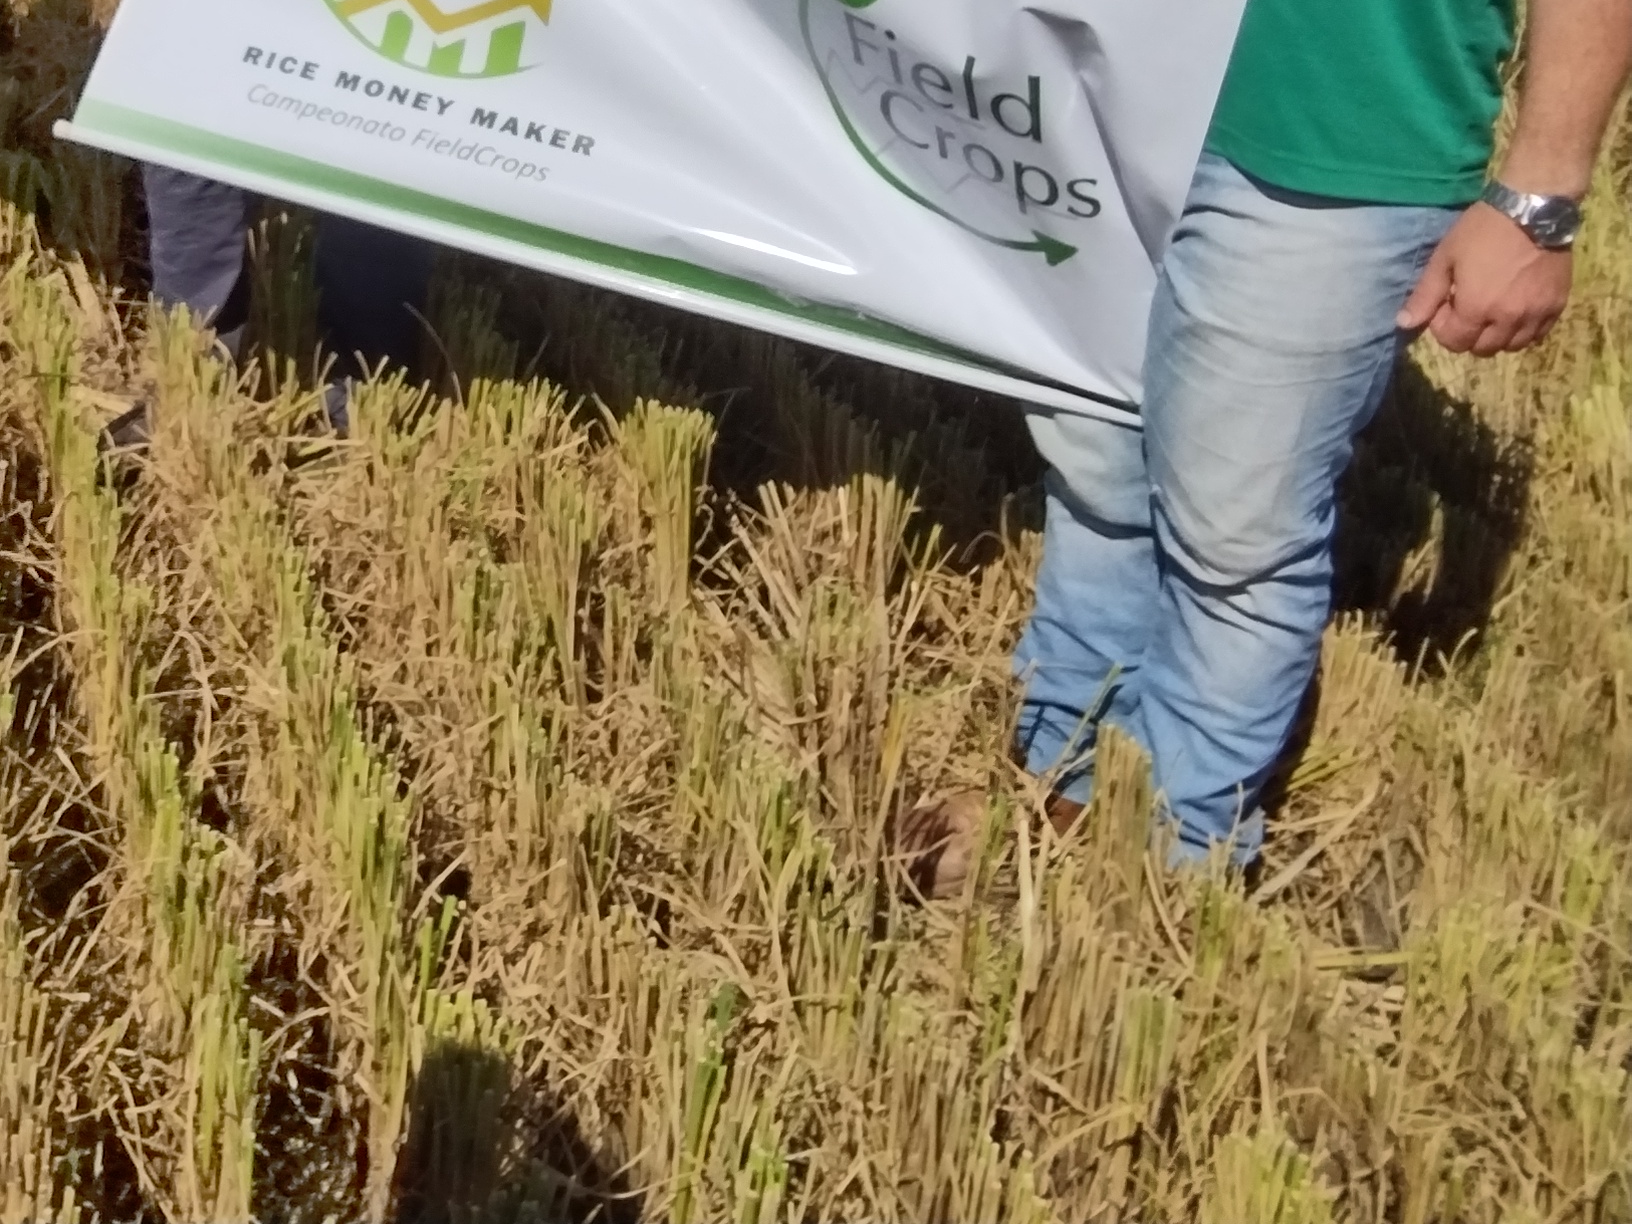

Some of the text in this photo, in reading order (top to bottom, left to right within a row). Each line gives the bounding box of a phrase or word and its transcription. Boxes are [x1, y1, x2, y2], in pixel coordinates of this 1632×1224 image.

[243, 46, 596, 156] RICE MONEY MAKER
[247, 83, 550, 182] Campeonato FieldCrops
[843, 11, 1042, 143] Field
[880, 89, 1102, 218] Crops
